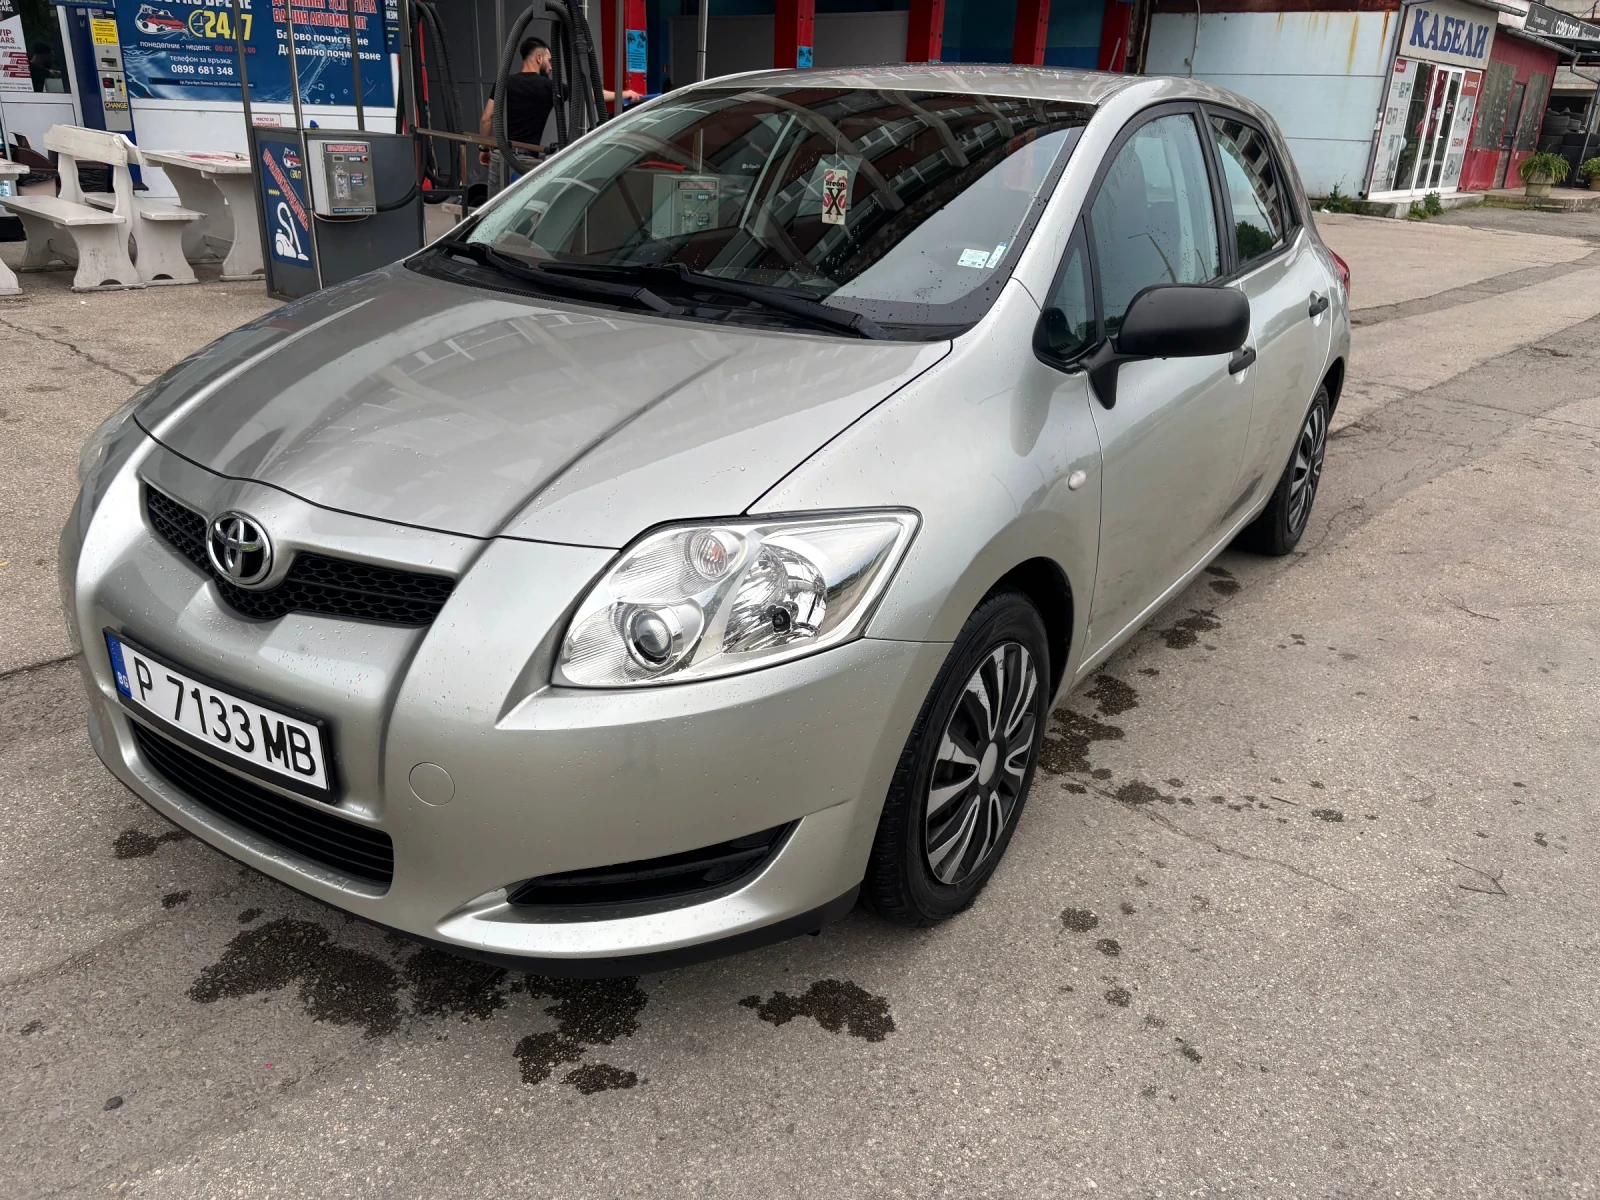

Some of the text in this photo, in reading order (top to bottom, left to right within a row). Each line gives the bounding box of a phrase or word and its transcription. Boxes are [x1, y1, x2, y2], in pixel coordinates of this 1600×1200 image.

[310, 11, 367, 29] АВТОМОИЛ
[276, 29, 369, 46] Баово почиствне
[1409, 8, 1489, 59] КАБЕЛИ
[170, 55, 198, 64] телефон
[278, 44, 381, 60] Деайлно почиване
[171, 64, 234, 75] 0898 681 348
[824, 187, 844, 216] X
[117, 671, 129, 689] BG
[133, 656, 317, 777] P 7133 MB
